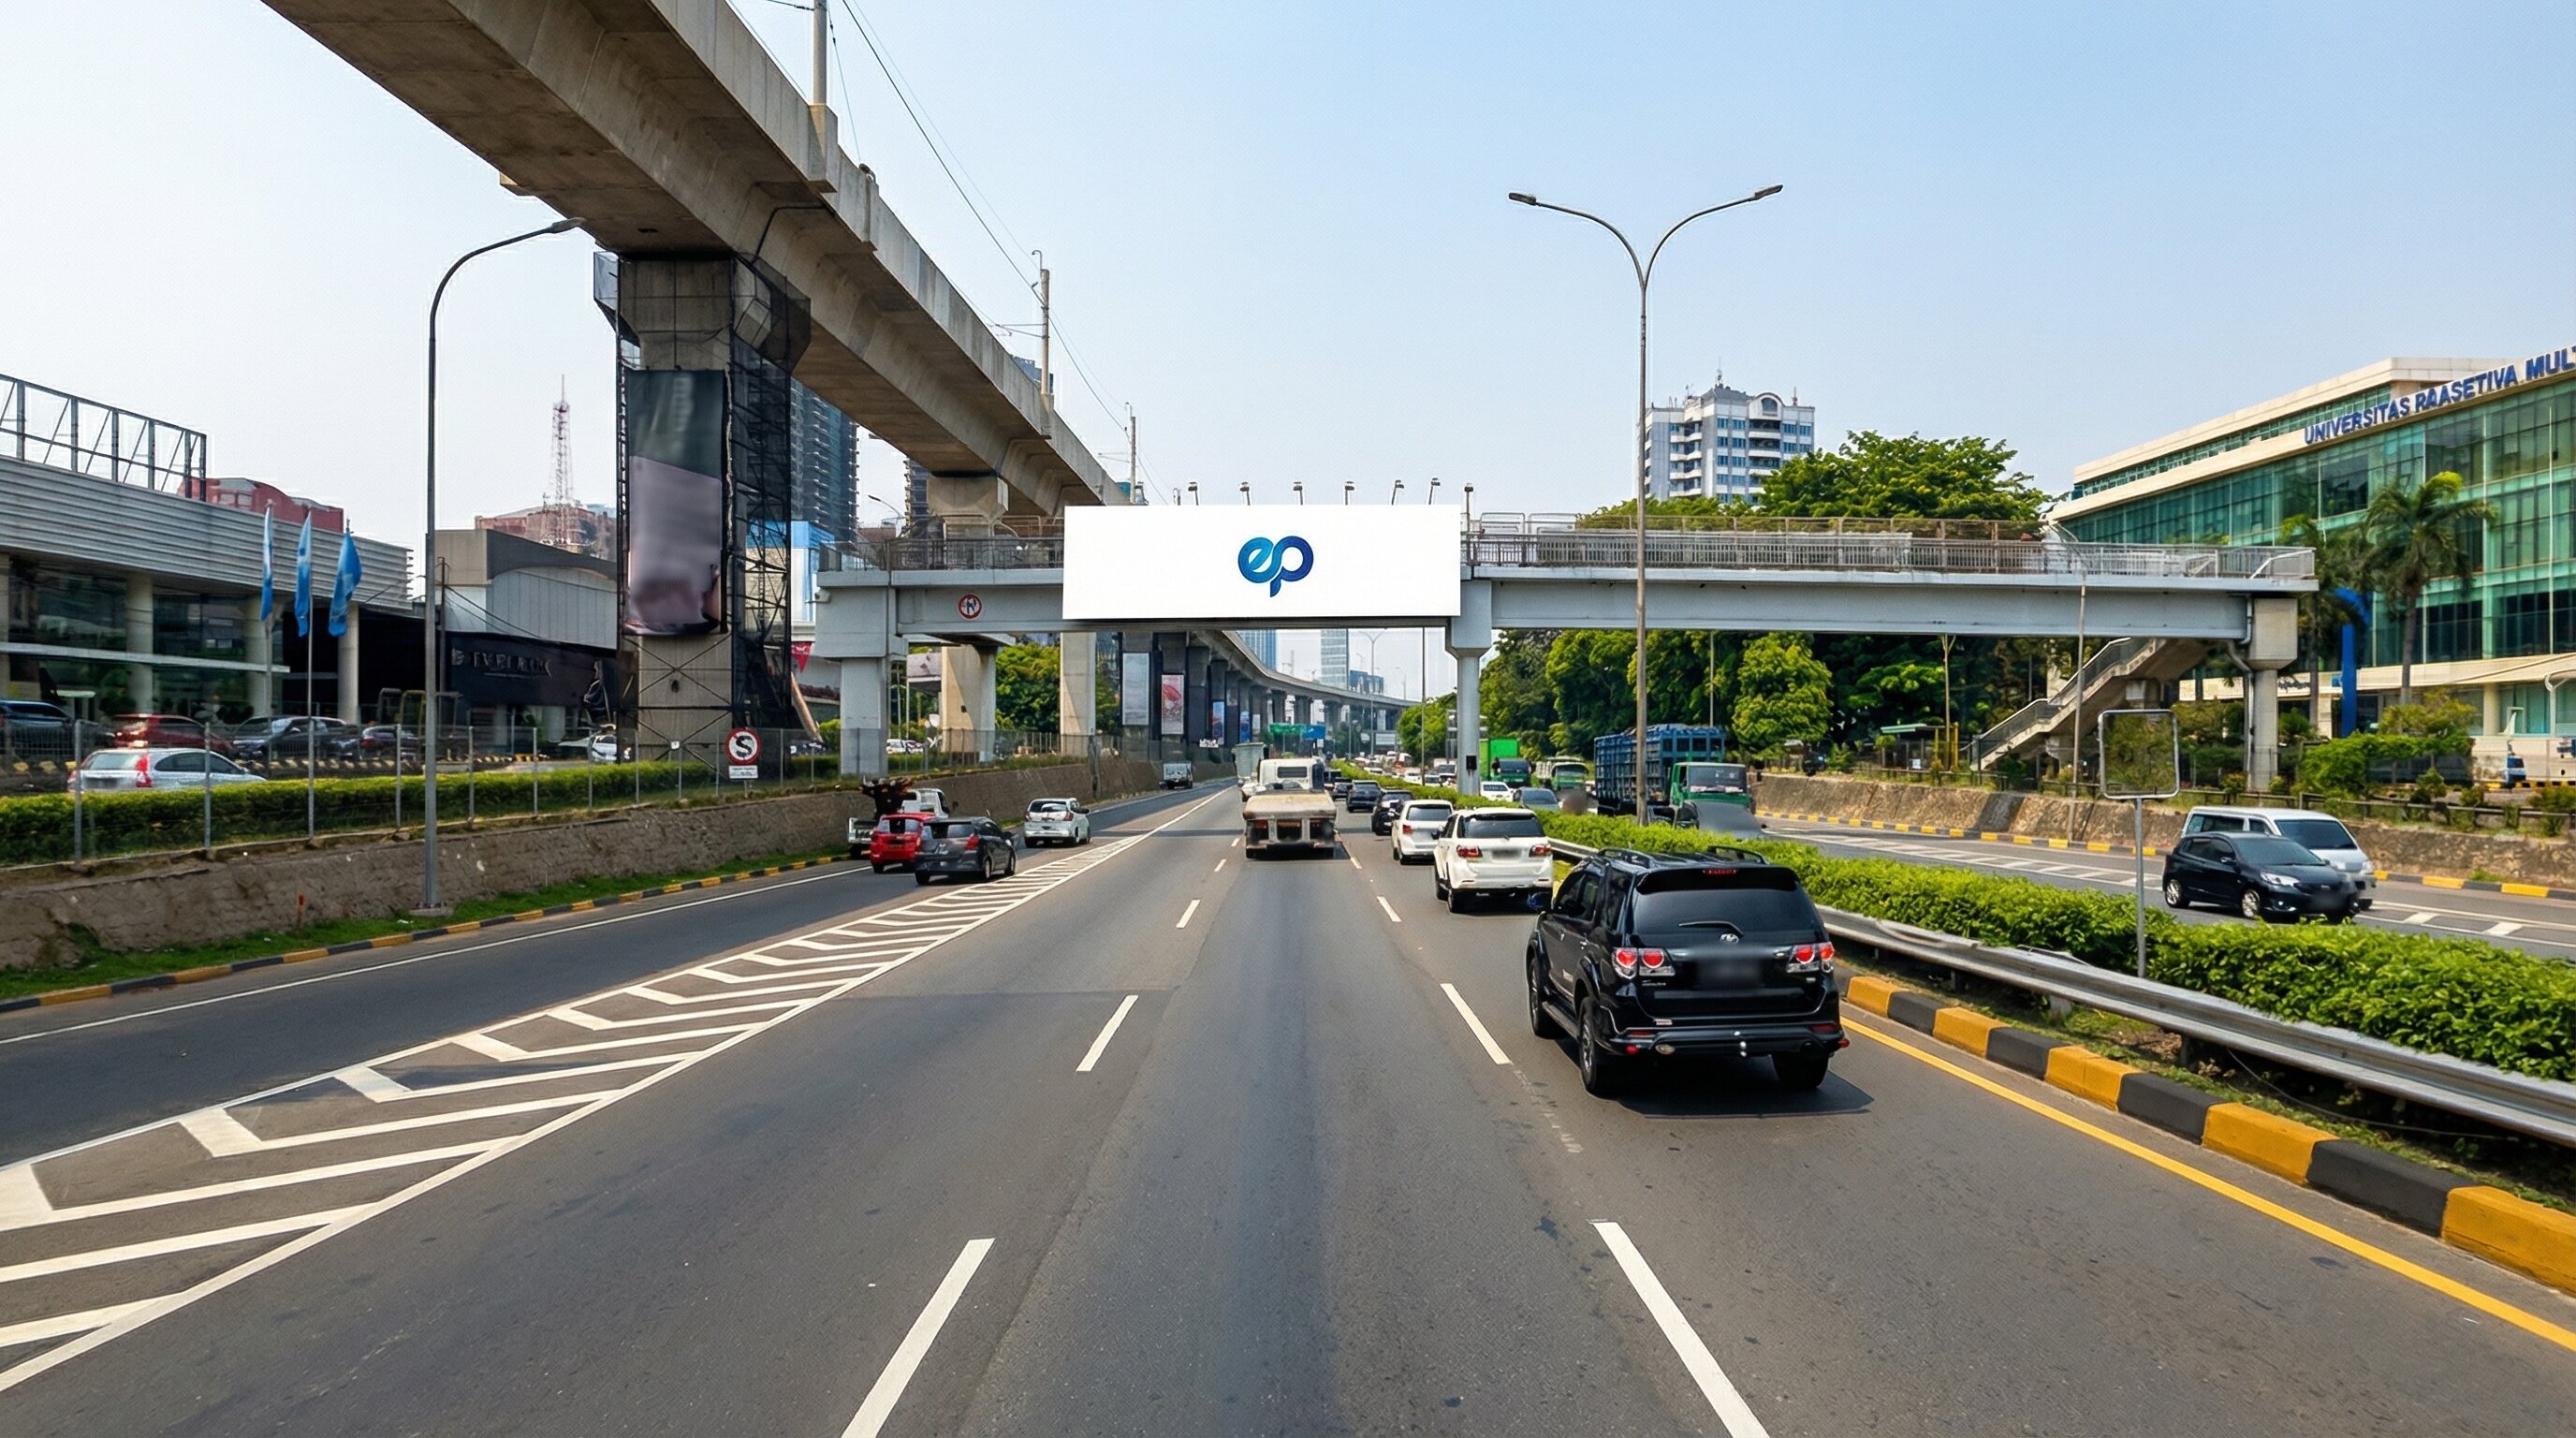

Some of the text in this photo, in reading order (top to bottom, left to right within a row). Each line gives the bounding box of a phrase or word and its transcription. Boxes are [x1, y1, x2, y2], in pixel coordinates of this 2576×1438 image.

[2305, 345, 2576, 444] UNIVERSITAS RAASETIVA MUL
